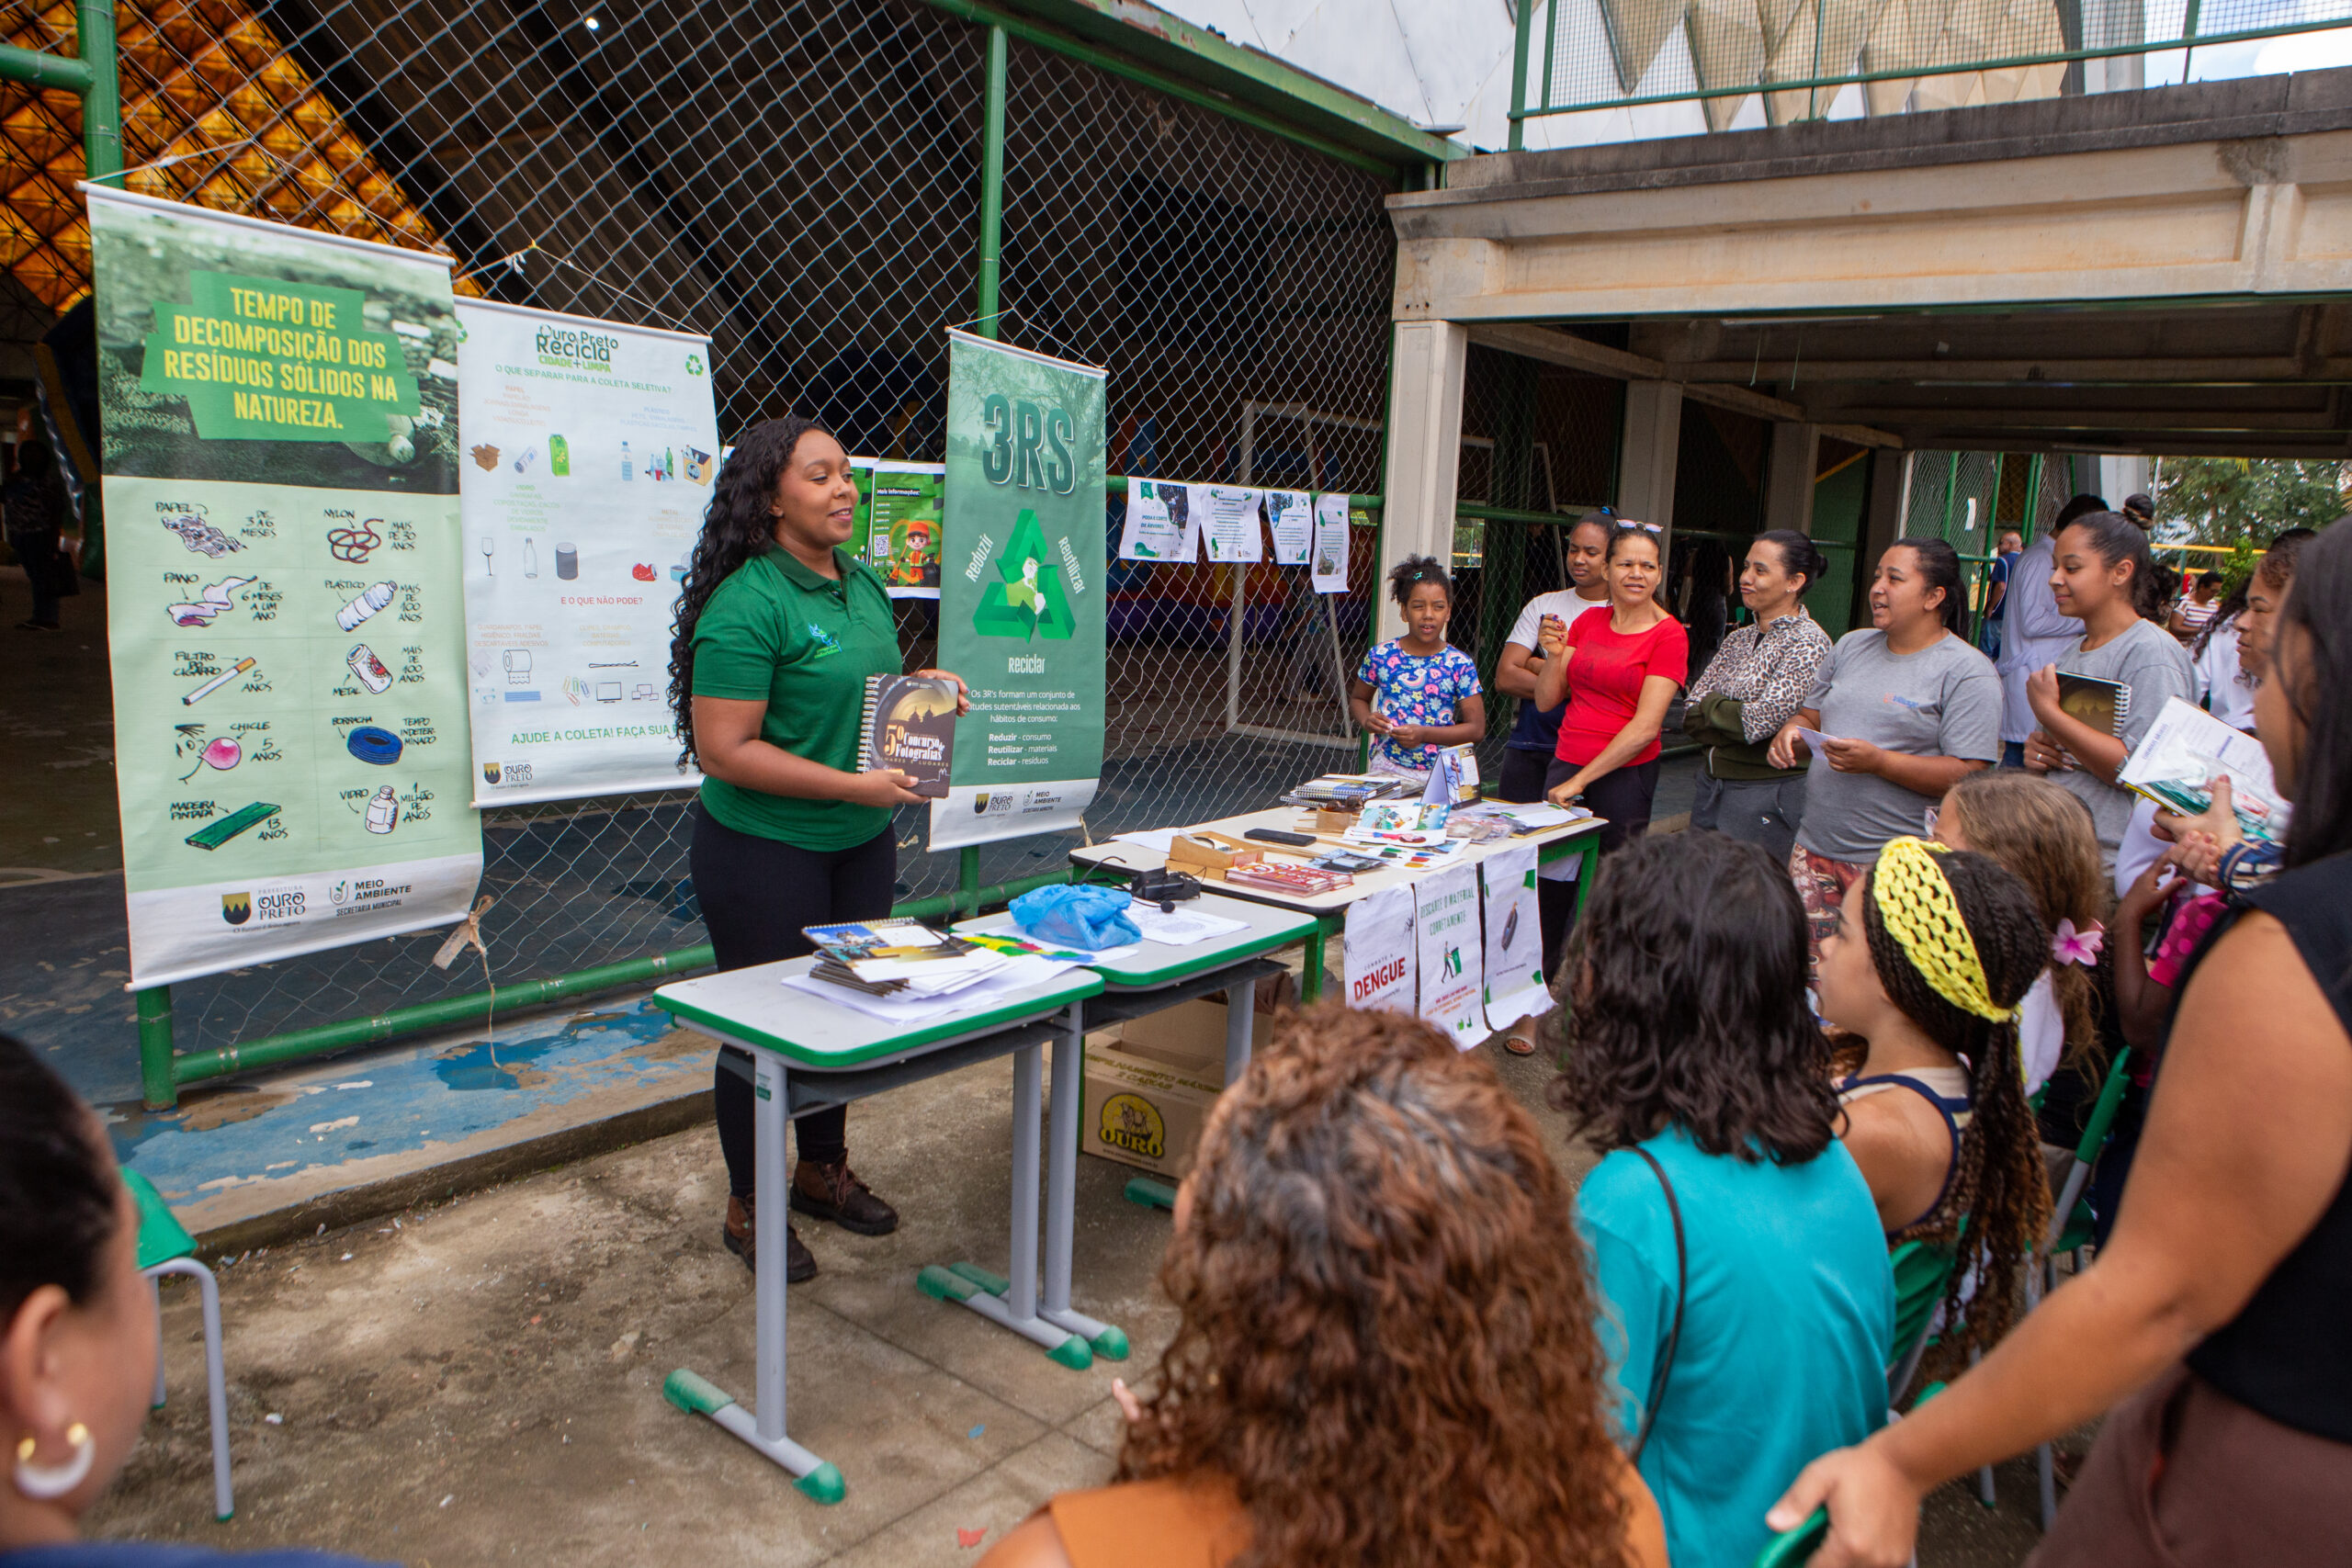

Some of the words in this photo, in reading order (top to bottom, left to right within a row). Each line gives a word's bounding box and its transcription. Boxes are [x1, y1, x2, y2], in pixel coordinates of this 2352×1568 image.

[230, 288, 304, 325] TEMPO
[311, 300, 336, 330] DE
[174, 315, 342, 365] DECOMPOSIÇÃO
[348, 342, 387, 369] DOS
[538, 324, 577, 343] Ouro
[580, 331, 619, 350] Preto
[536, 333, 611, 362] Recicla
[164, 349, 274, 389] RESÍDUOS
[280, 361, 366, 399] SÓLIDOS
[371, 377, 399, 402] NA
[495, 364, 503, 372] O
[504, 366, 522, 376] QUE
[524, 367, 564, 380] SEPARAR
[566, 374, 589, 383] PARA
[598, 378, 630, 389] COLETA
[631, 382, 672, 394] SELETIVA?
[233, 391, 344, 429] NATUREZA.
[982, 393, 1076, 496] 3RS
[155, 502, 193, 513] PAPEL
[256, 510, 271, 518] DE
[323, 509, 355, 519] NYLON
[245, 516, 254, 525] 3
[257, 518, 264, 526] A
[265, 517, 274, 526] 6
[391, 522, 413, 530] MAIS
[241, 528, 277, 538] MESES
[388, 531, 400, 540] DE
[390, 542, 414, 550] ANOS
[965, 533, 994, 582] Reduzir
[1057, 536, 1085, 594] Reutilizar
[164, 572, 199, 583] PANO
[259, 581, 273, 591] DE
[400, 583, 421, 593] MAIS
[242, 590, 251, 601] 6
[252, 592, 283, 601] MESES
[405, 593, 416, 602] DE
[577, 597, 594, 605] QUE
[597, 594, 615, 604] NÃO
[616, 596, 643, 604] PODE?
[250, 603, 258, 611] A
[261, 603, 277, 611] UM
[401, 602, 421, 612] 100
[253, 612, 276, 621] ANO
[398, 613, 423, 622] ANOS
[175, 651, 216, 661] FILTRO
[402, 646, 423, 655] MAIS
[402, 664, 423, 673] 100
[1008, 654, 1046, 674] Reciclar
[173, 667, 221, 677] CIGARRO
[253, 670, 264, 682] 5
[398, 672, 425, 682] ANOS
[241, 681, 273, 693] ANOS
[333, 687, 361, 696] METAL
[970, 690, 980, 698] Os
[982, 690, 997, 698] 3R's
[999, 690, 1025, 698] formam
[1038, 691, 1066, 700] conjunto
[1033, 702, 1069, 710] relacionada
[332, 716, 373, 726] BORRACHA
[402, 717, 430, 726] TEMPO
[989, 715, 1015, 723] hábitos
[1017, 715, 1026, 723] de
[230, 721, 271, 730] CHICLE
[512, 731, 551, 744] AJUDE
[554, 731, 562, 741] A
[565, 728, 614, 741] COLETA!
[616, 726, 646, 738] FAÇA
[648, 724, 670, 736] SUA
[989, 733, 1017, 741] Reduzir
[262, 738, 274, 750] 5
[404, 736, 436, 745] MINADO
[903, 732, 940, 750] Concurso
[895, 743, 943, 761] Fotografias
[988, 745, 1023, 754] Reutilizar
[250, 750, 282, 761] ANOS
[988, 757, 1016, 766] Reciclar
[503, 764, 532, 775] OURO
[505, 773, 533, 783] PRETO
[413, 782, 418, 793] 1
[339, 789, 368, 800] VIDRO
[401, 790, 435, 803] MILHÃO
[170, 801, 216, 811] MADEIRA
[411, 802, 423, 810] DE
[990, 796, 1013, 805] OURO
[171, 810, 213, 820] PINTADA
[402, 807, 431, 823] ANOS
[267, 818, 281, 829] 13
[257, 828, 288, 840] ANOS
[355, 879, 384, 890] MEIO
[355, 885, 412, 901] AMBIENTE
[258, 892, 305, 909] OURO
[1420, 897, 1442, 919] DESCARTE
[1449, 886, 1475, 905] MATERIAL
[259, 905, 306, 919] PRETO
[336, 905, 370, 917] SECRETARIA
[371, 899, 402, 911] MUNICIPAL
[1430, 909, 1465, 936] CORRETAMENTE
[1353, 956, 1406, 1002] DENGUE
[1100, 1127, 1165, 1158] OURO
